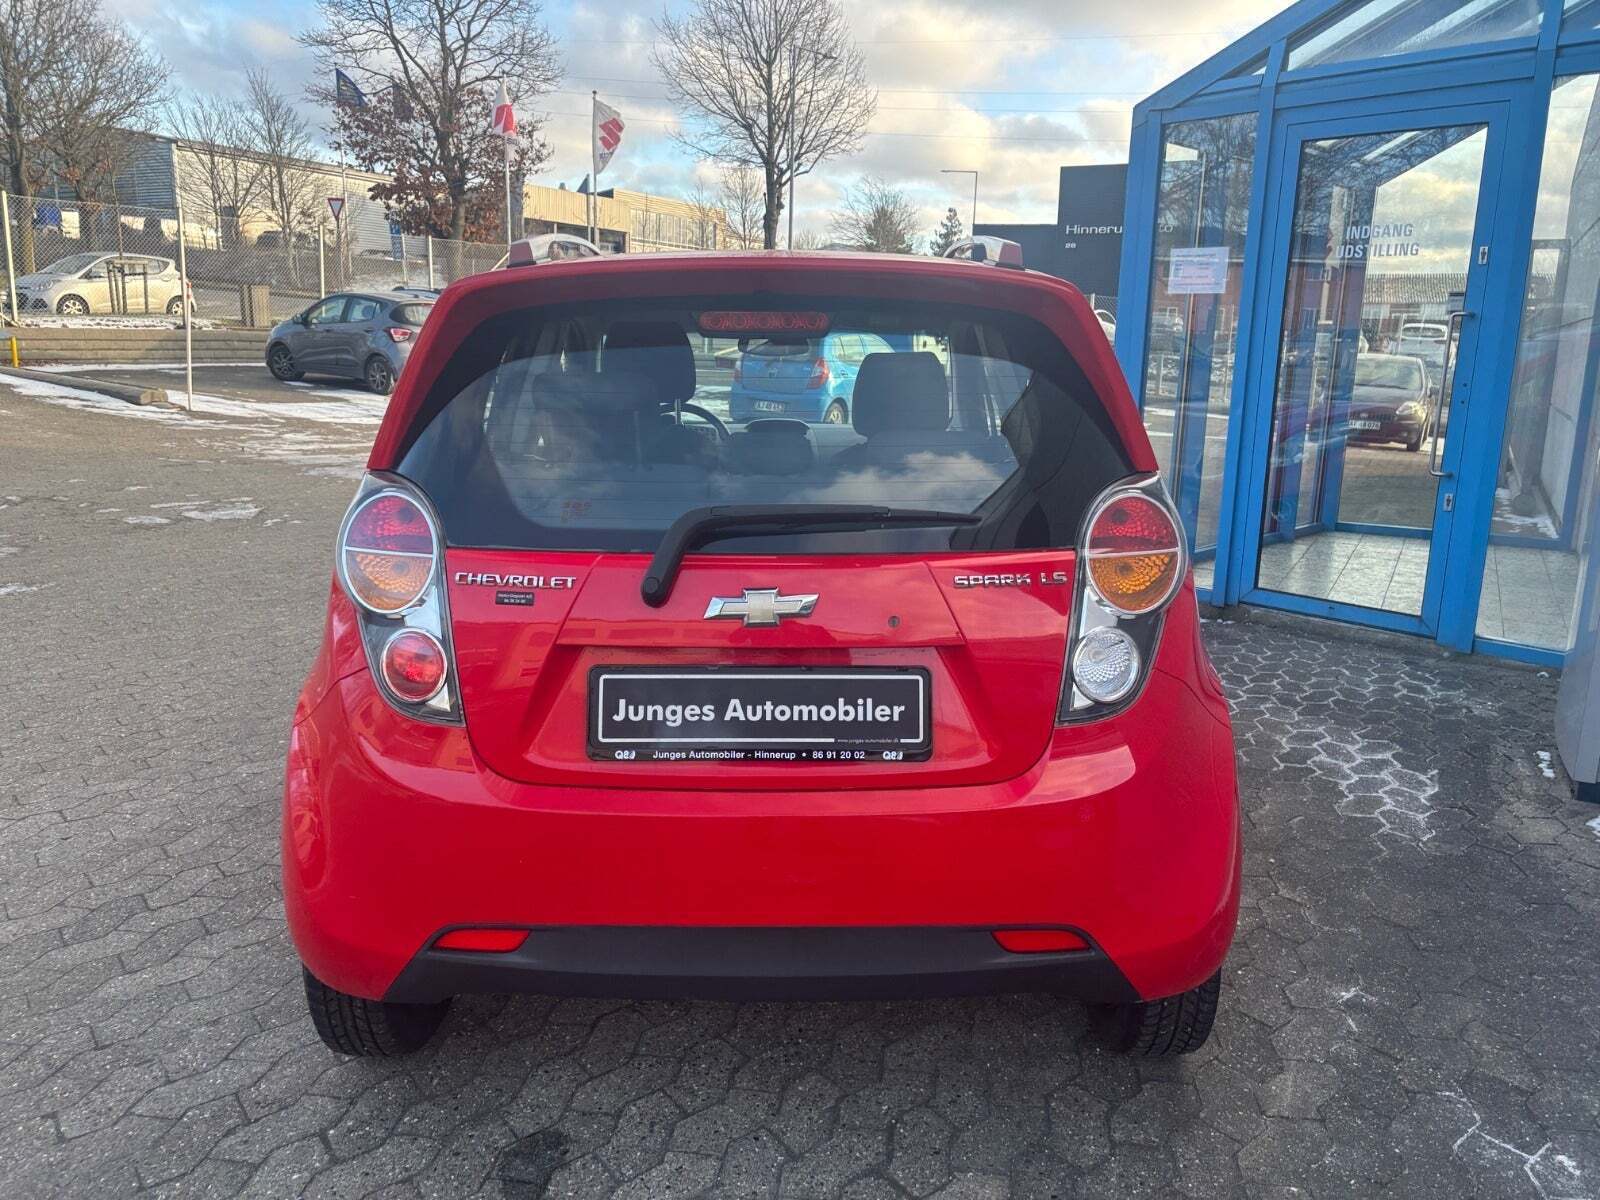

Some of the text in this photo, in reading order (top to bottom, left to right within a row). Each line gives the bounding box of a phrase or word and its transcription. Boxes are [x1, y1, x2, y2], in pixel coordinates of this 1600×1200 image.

[1065, 224, 1123, 235] Hinneru
[1345, 223, 1414, 240] INDGANG
[1335, 242, 1420, 259] UDSTILLING
[454, 572, 577, 589] CHEVROLET
[953, 571, 1068, 588] SPARK LS
[612, 698, 906, 727] Junges Automobiler
[652, 750, 687, 760] Junges
[689, 750, 746, 759] Automobiler
[754, 750, 796, 760] Hinnerup
[812, 751, 824, 759] 86
[826, 751, 837, 759] 91
[840, 751, 852, 759] 20
[854, 751, 865, 759] 02
